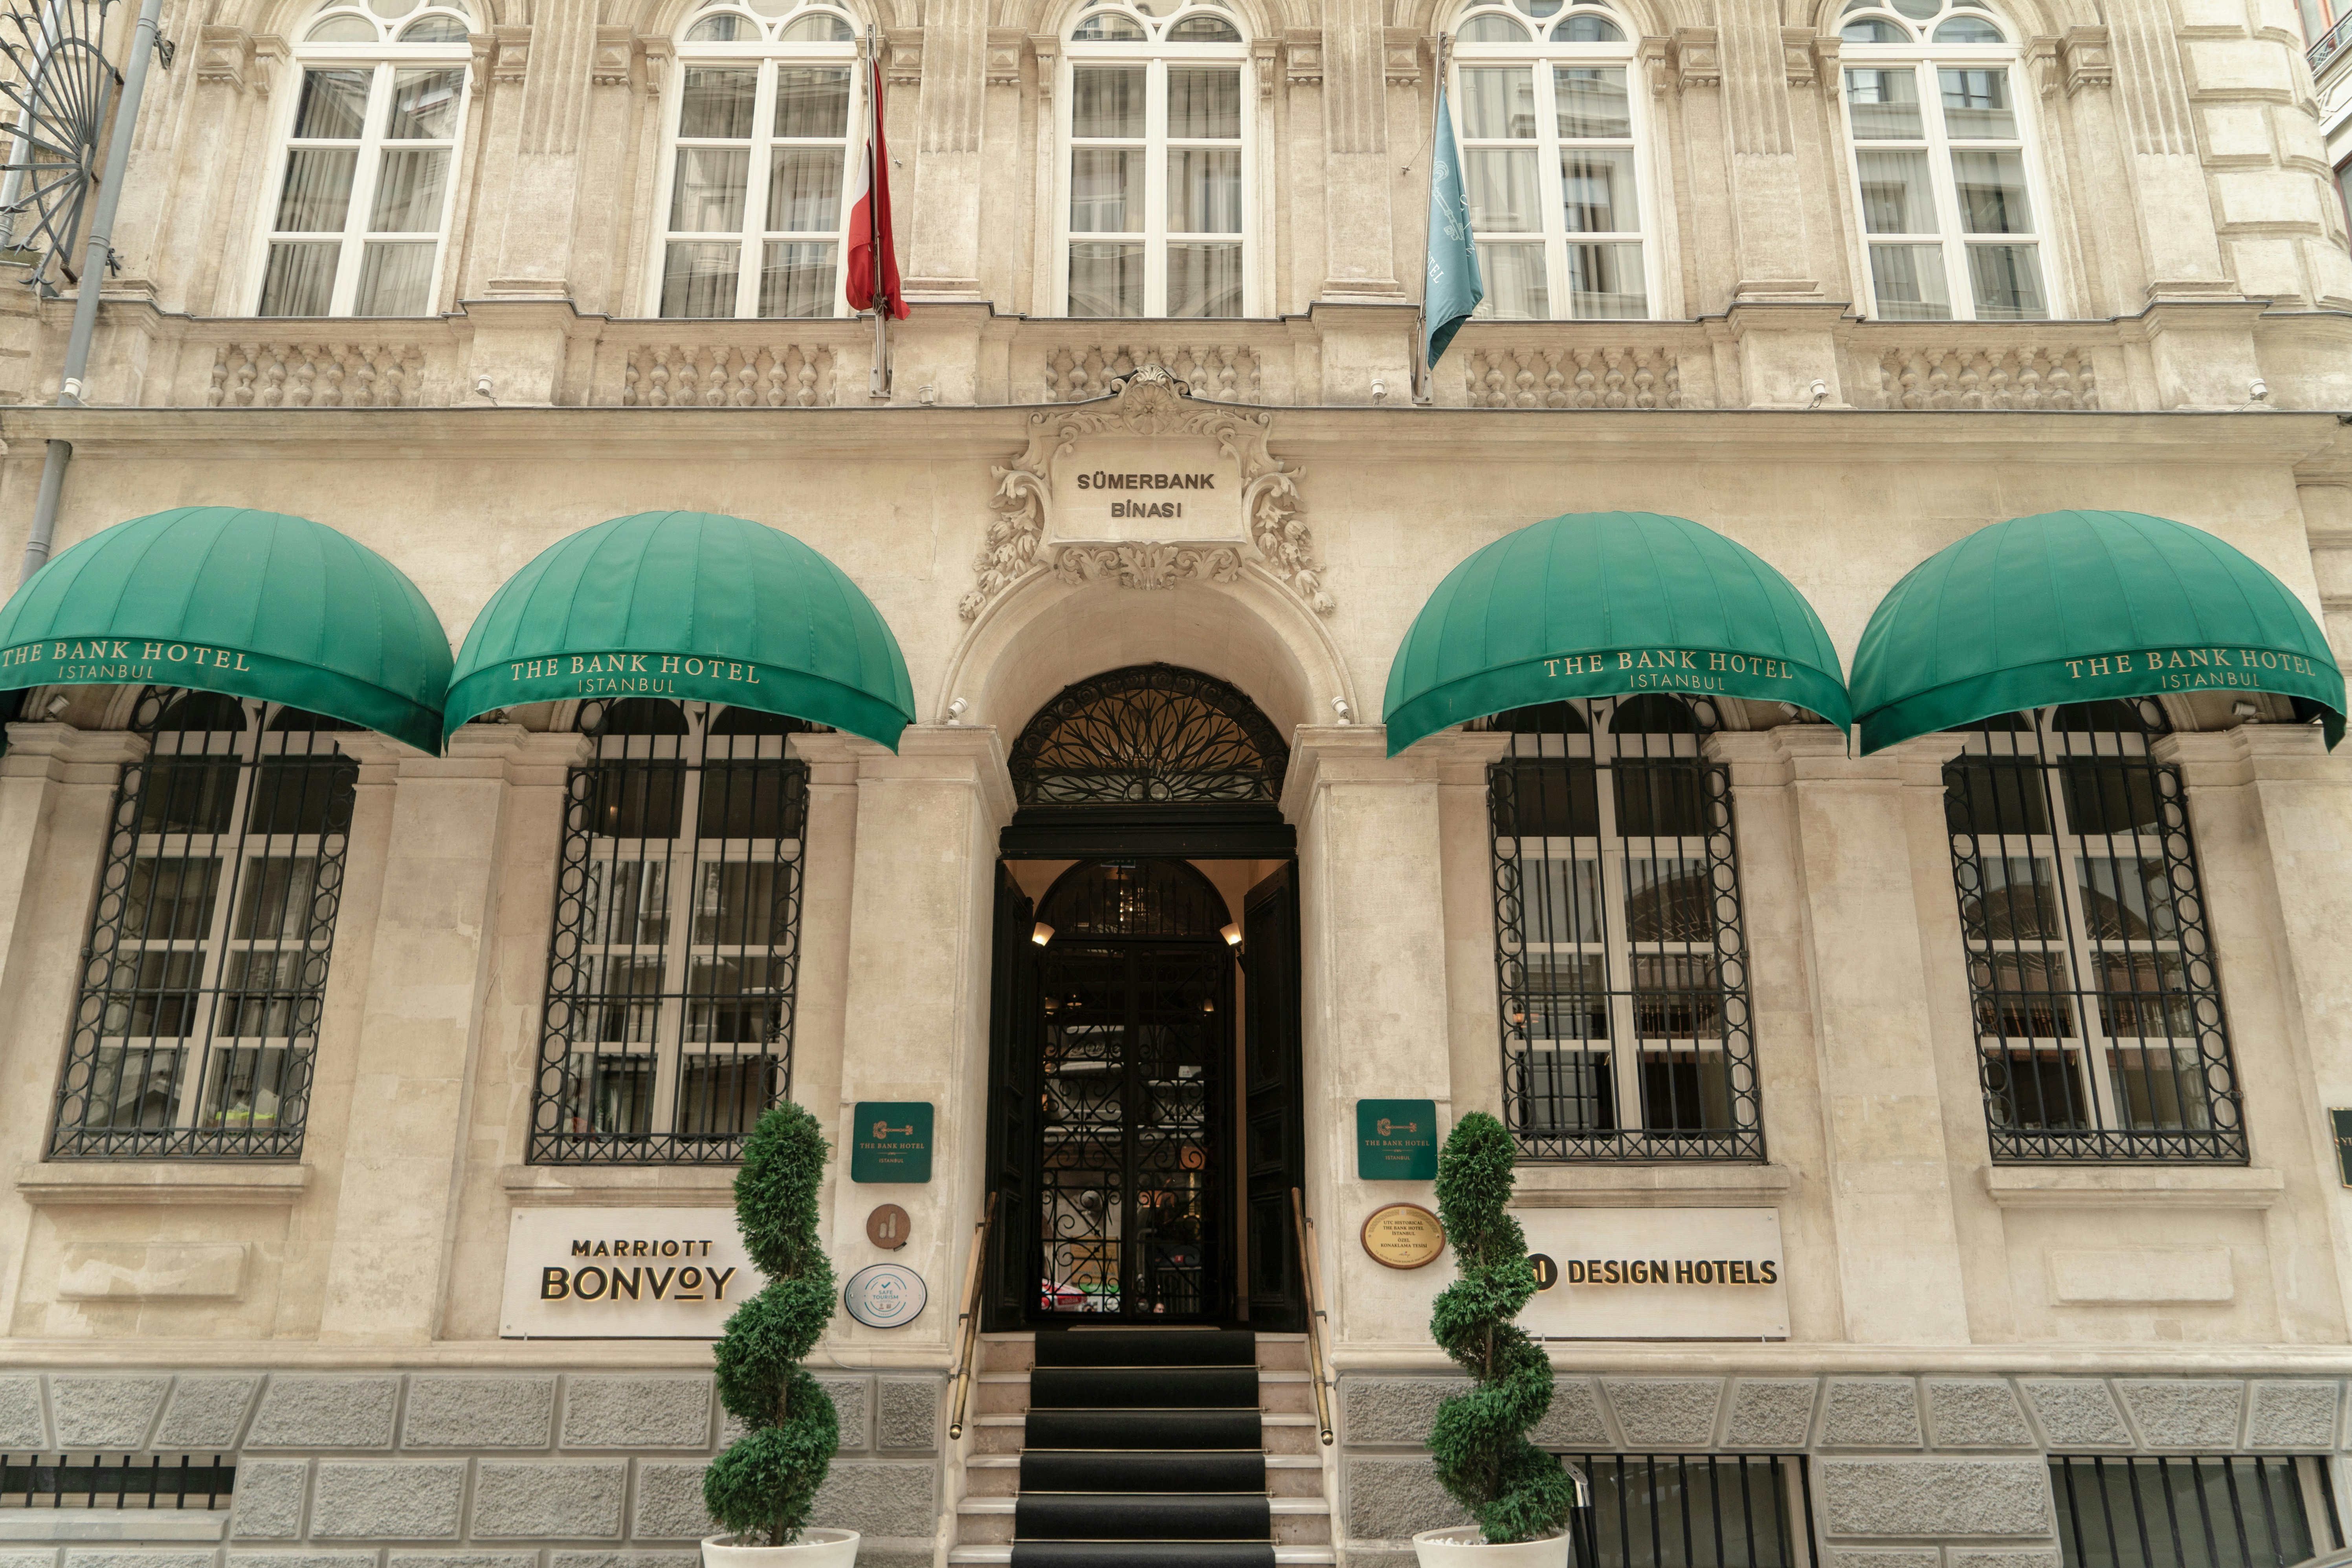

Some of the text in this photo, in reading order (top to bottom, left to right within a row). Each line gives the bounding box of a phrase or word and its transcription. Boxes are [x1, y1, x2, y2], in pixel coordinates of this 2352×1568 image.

[1077, 471, 1215, 489] SÜMERBANK
[1111, 499, 1181, 518] BİNASI
[2, 641, 250, 672] THE BANK HOTEL
[1544, 651, 1793, 679] THE BANK HOTEL
[2066, 649, 2316, 679] THE BANK HOTEL
[59, 664, 153, 679] ISTANBUL
[511, 655, 760, 684] THE BANK HOTEL
[579, 678, 674, 693] ISTANBUL
[1631, 674, 1725, 690] ISTANBUL
[2162, 672, 2260, 689] ISTANBUL
[571, 1240, 712, 1257] MARRIOTT
[1567, 1260, 1778, 1285] DESIGN HOTELS
[541, 1266, 736, 1300] BONVOY
